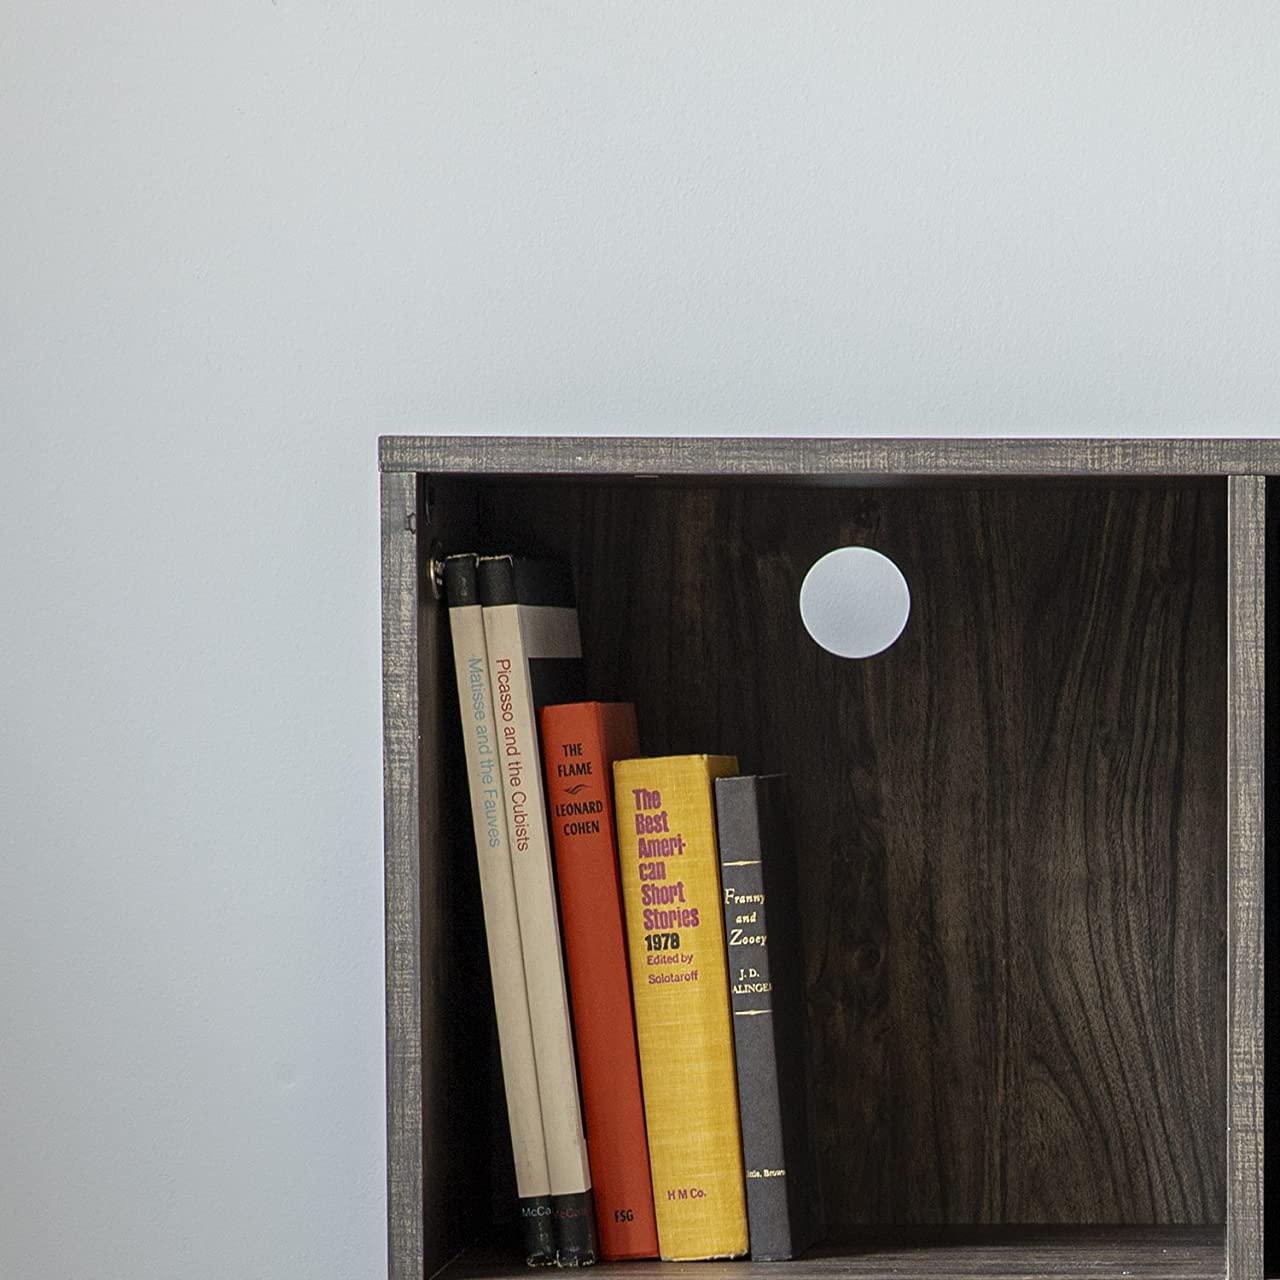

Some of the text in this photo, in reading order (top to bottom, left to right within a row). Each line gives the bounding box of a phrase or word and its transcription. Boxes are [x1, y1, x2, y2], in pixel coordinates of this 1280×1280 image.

[468, 657, 501, 847] Matisse and the Fauves
[495, 658, 531, 851] Picasso and the Cubists
[562, 744, 582, 756] THE
[558, 762, 592, 777] FLAME
[632, 789, 662, 810] The
[556, 800, 602, 816] LEONARD
[564, 820, 600, 836] COHEN
[636, 811, 670, 835] Best
[638, 834, 686, 858] Ameri-
[638, 862, 666, 882] can
[640, 881, 686, 906] Short
[724, 888, 765, 905] Franny
[642, 907, 700, 931] Stories
[736, 912, 757, 924] and
[729, 929, 768, 947] Zooey
[647, 954, 694, 966] Edited by
[648, 970, 698, 984] Solotaroff
[739, 968, 760, 980] J. D.
[667, 1188, 707, 1200] H M Co.
[614, 1209, 634, 1223] FSG
